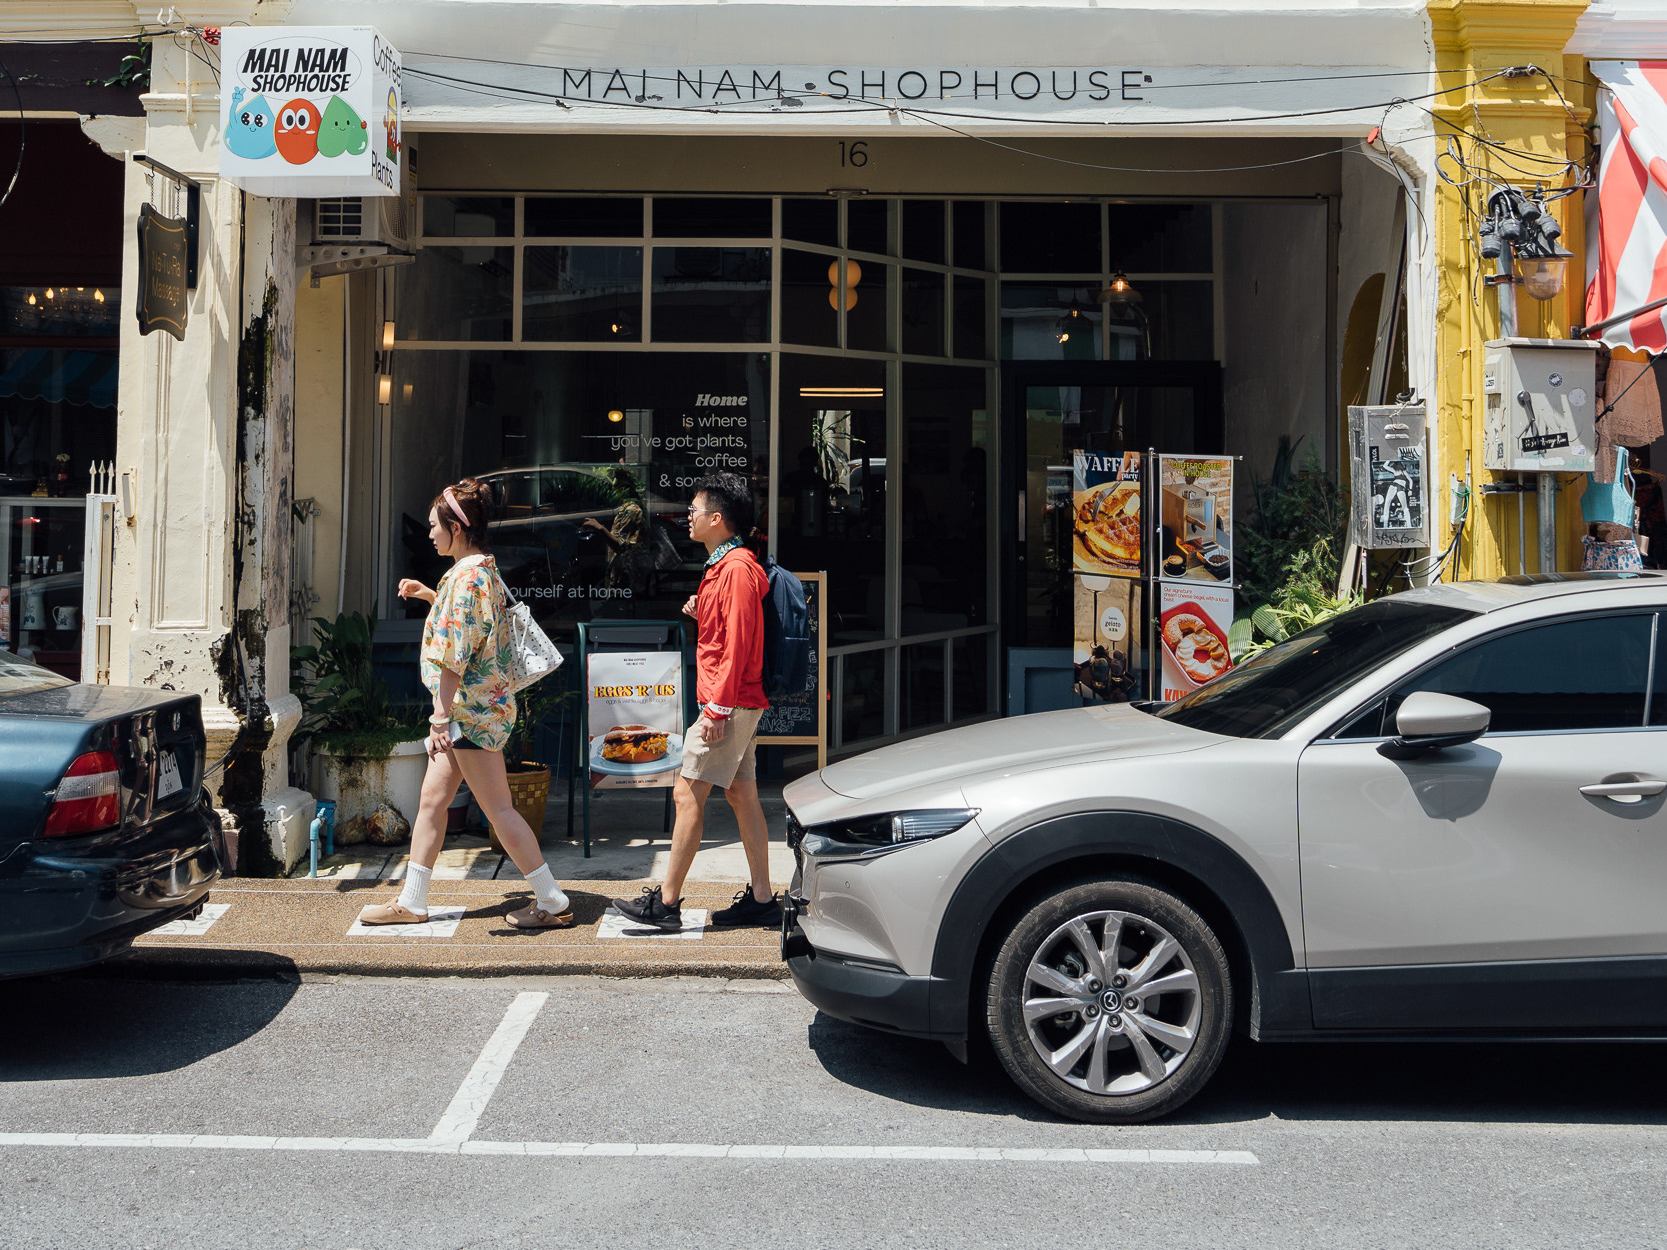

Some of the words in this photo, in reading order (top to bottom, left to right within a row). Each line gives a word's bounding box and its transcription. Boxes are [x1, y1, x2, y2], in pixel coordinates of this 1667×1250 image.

[242, 48, 290, 73] MAI
[293, 47, 349, 73] NAM
[251, 73, 352, 93] SHOPHOUSE
[563, 69, 647, 99] MAI
[677, 69, 783, 99] NAM
[828, 70, 1145, 100] SHOPHOUSE
[838, 141, 868, 168] 16
[371, 150, 394, 190] Plants
[695, 393, 748, 406] Home
[682, 414, 694, 427] is
[698, 413, 748, 427] where
[665, 435, 693, 451] got
[697, 433, 748, 450] plants,
[695, 453, 748, 468] coffee
[1075, 456, 1139, 473] WAFFLE
[1171, 461, 1194, 470] COFFEE
[1193, 462, 1223, 471] ROASTED
[659, 473, 671, 488] &
[1121, 473, 1139, 482] party
[1182, 469, 1190, 477] IN
[1190, 469, 1212, 478] HOUSE
[567, 586, 585, 599] at
[589, 584, 633, 599] home
[594, 685, 634, 698] EGGS
[653, 684, 676, 696] US
